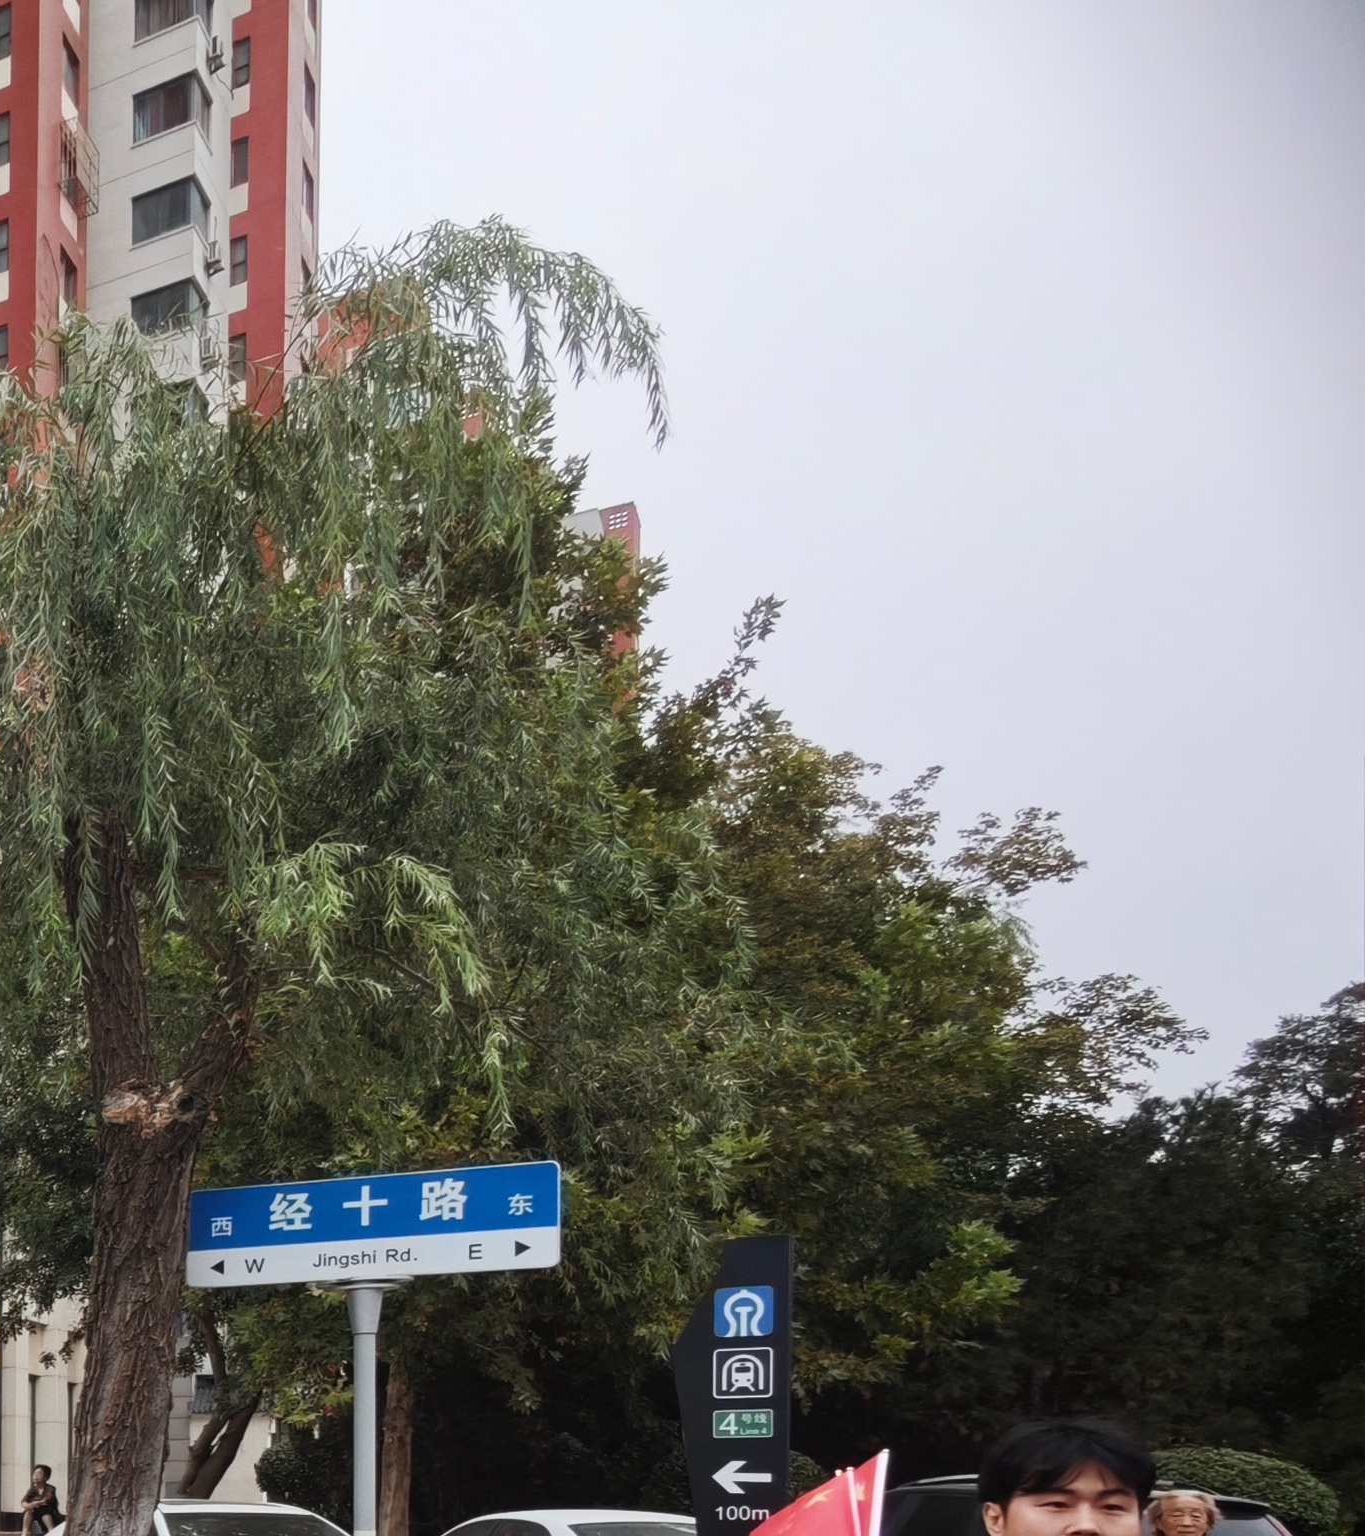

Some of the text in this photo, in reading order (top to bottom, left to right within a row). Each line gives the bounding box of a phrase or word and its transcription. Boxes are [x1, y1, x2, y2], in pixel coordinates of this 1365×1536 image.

[210, 1178, 534, 1237] 西 经十路 东
[244, 1243, 483, 1274] W Jingshi Rd. E
[719, 1413, 738, 1435] 4
[715, 1506, 769, 1520] 100m
